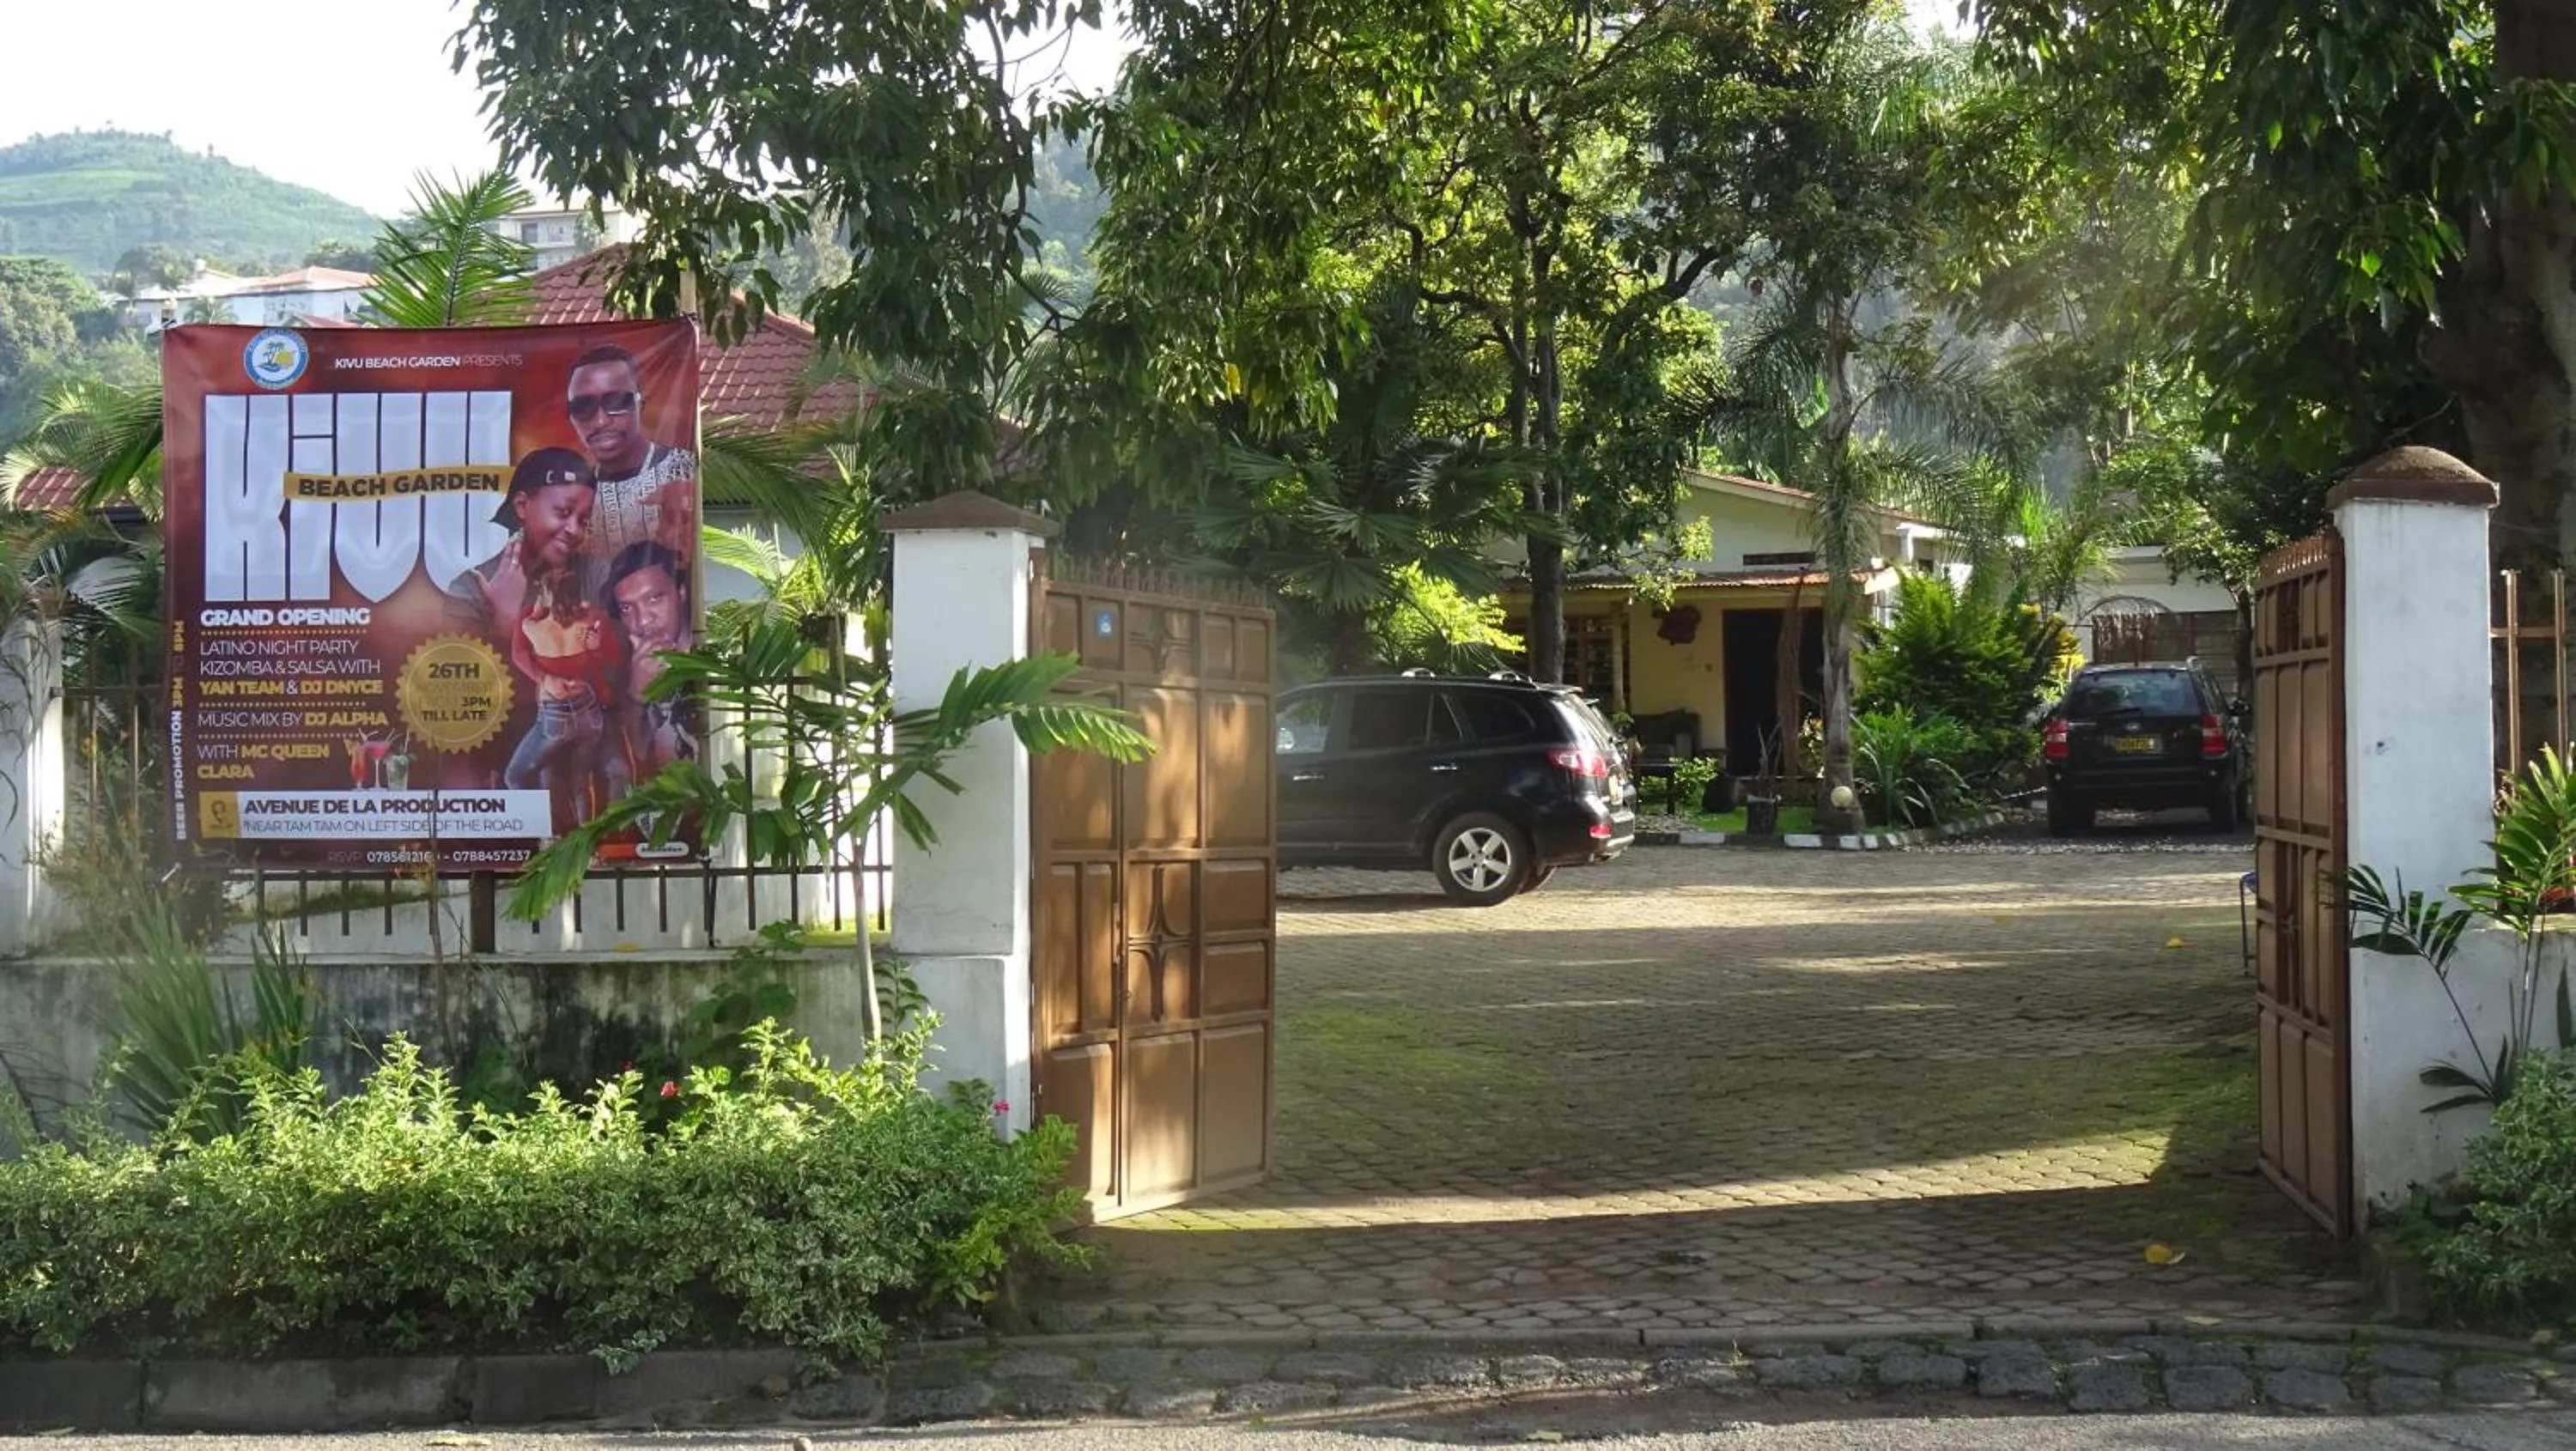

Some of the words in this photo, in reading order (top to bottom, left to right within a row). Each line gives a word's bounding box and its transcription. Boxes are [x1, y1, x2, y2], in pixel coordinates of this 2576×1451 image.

[335, 357, 363, 369] KIVU
[365, 356, 408, 368] BEACH
[409, 355, 461, 367] GARDEN
[462, 354, 522, 367] PRESENTS
[298, 477, 386, 497] BEACH
[392, 473, 500, 494] GARDEN
[199, 609, 274, 627] GRAND
[276, 608, 371, 626] OPENING
[199, 641, 256, 656] LATINO
[258, 640, 308, 655] NIGHT
[310, 640, 359, 655] PARTY
[200, 659, 274, 676] KIZOMBA
[275, 659, 287, 675] &
[287, 659, 337, 674] SALSA
[337, 659, 380, 674] WITH
[428, 662, 480, 679] 26TH
[198, 681, 234, 695] YAN
[236, 680, 284, 695] TEAM
[286, 679, 299, 695] &
[301, 680, 323, 695] DJ
[197, 712, 249, 727] MUSIC
[251, 712, 282, 726] MIX
[283, 712, 302, 727] BY
[304, 712, 328, 726] DJ
[329, 711, 389, 726] ALPHA
[421, 709, 450, 722] TILL
[453, 709, 489, 721] LATE
[171, 710, 185, 799] PROMOTION
[196, 744, 238, 760] WITH
[240, 744, 268, 758] MC
[270, 744, 331, 762] QUEEN
[197, 764, 255, 780] CLARA
[245, 799, 320, 815] AVENUE
[323, 799, 349, 814] DE
[353, 798, 378, 814] LA
[380, 798, 506, 814] PRODUCTION
[175, 801, 186, 841] BEER
[283, 820, 312, 832] TAM
[313, 820, 342, 832] TAM
[343, 820, 366, 832] ON
[368, 820, 400, 832] LEFT
[400, 820, 429, 832] SIDE
[434, 819, 450, 832] OF
[453, 819, 482, 832] THE
[483, 818, 524, 832] ROAD
